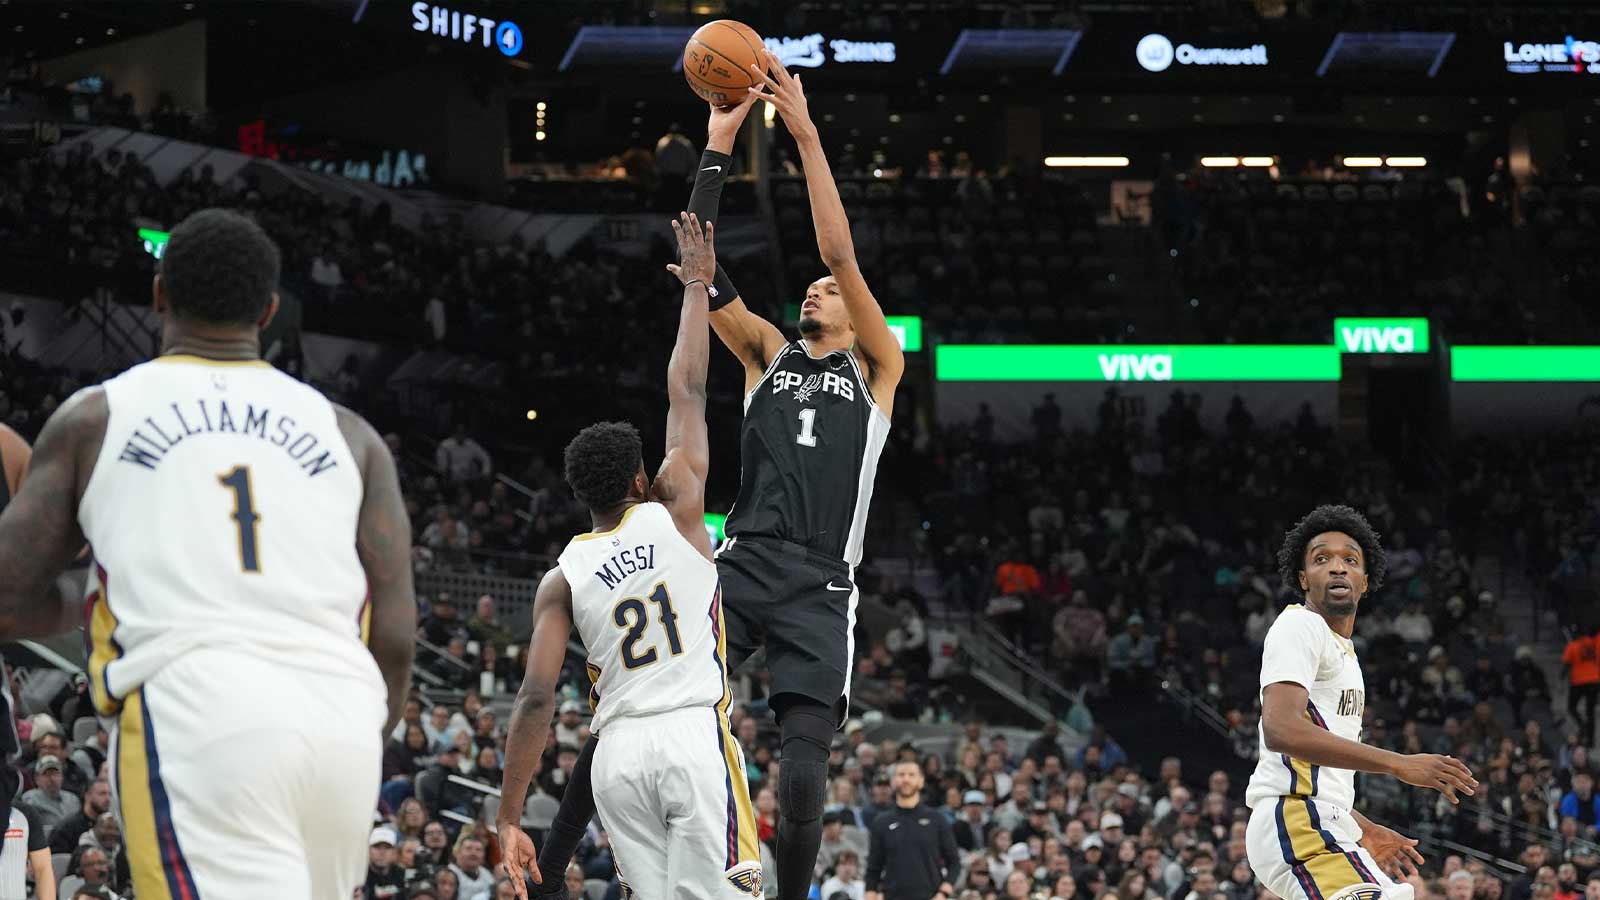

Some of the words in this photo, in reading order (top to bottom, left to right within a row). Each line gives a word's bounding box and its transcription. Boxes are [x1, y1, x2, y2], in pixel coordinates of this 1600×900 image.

[1503, 42, 1569, 62] LONE
[1340, 326, 1415, 353] viva
[1098, 353, 1174, 381] viva
[117, 399, 338, 477] WILLIAMSON
[796, 408, 817, 447] 1
[217, 464, 262, 574] 1
[595, 544, 655, 591] MISSI
[612, 580, 684, 672] 21
